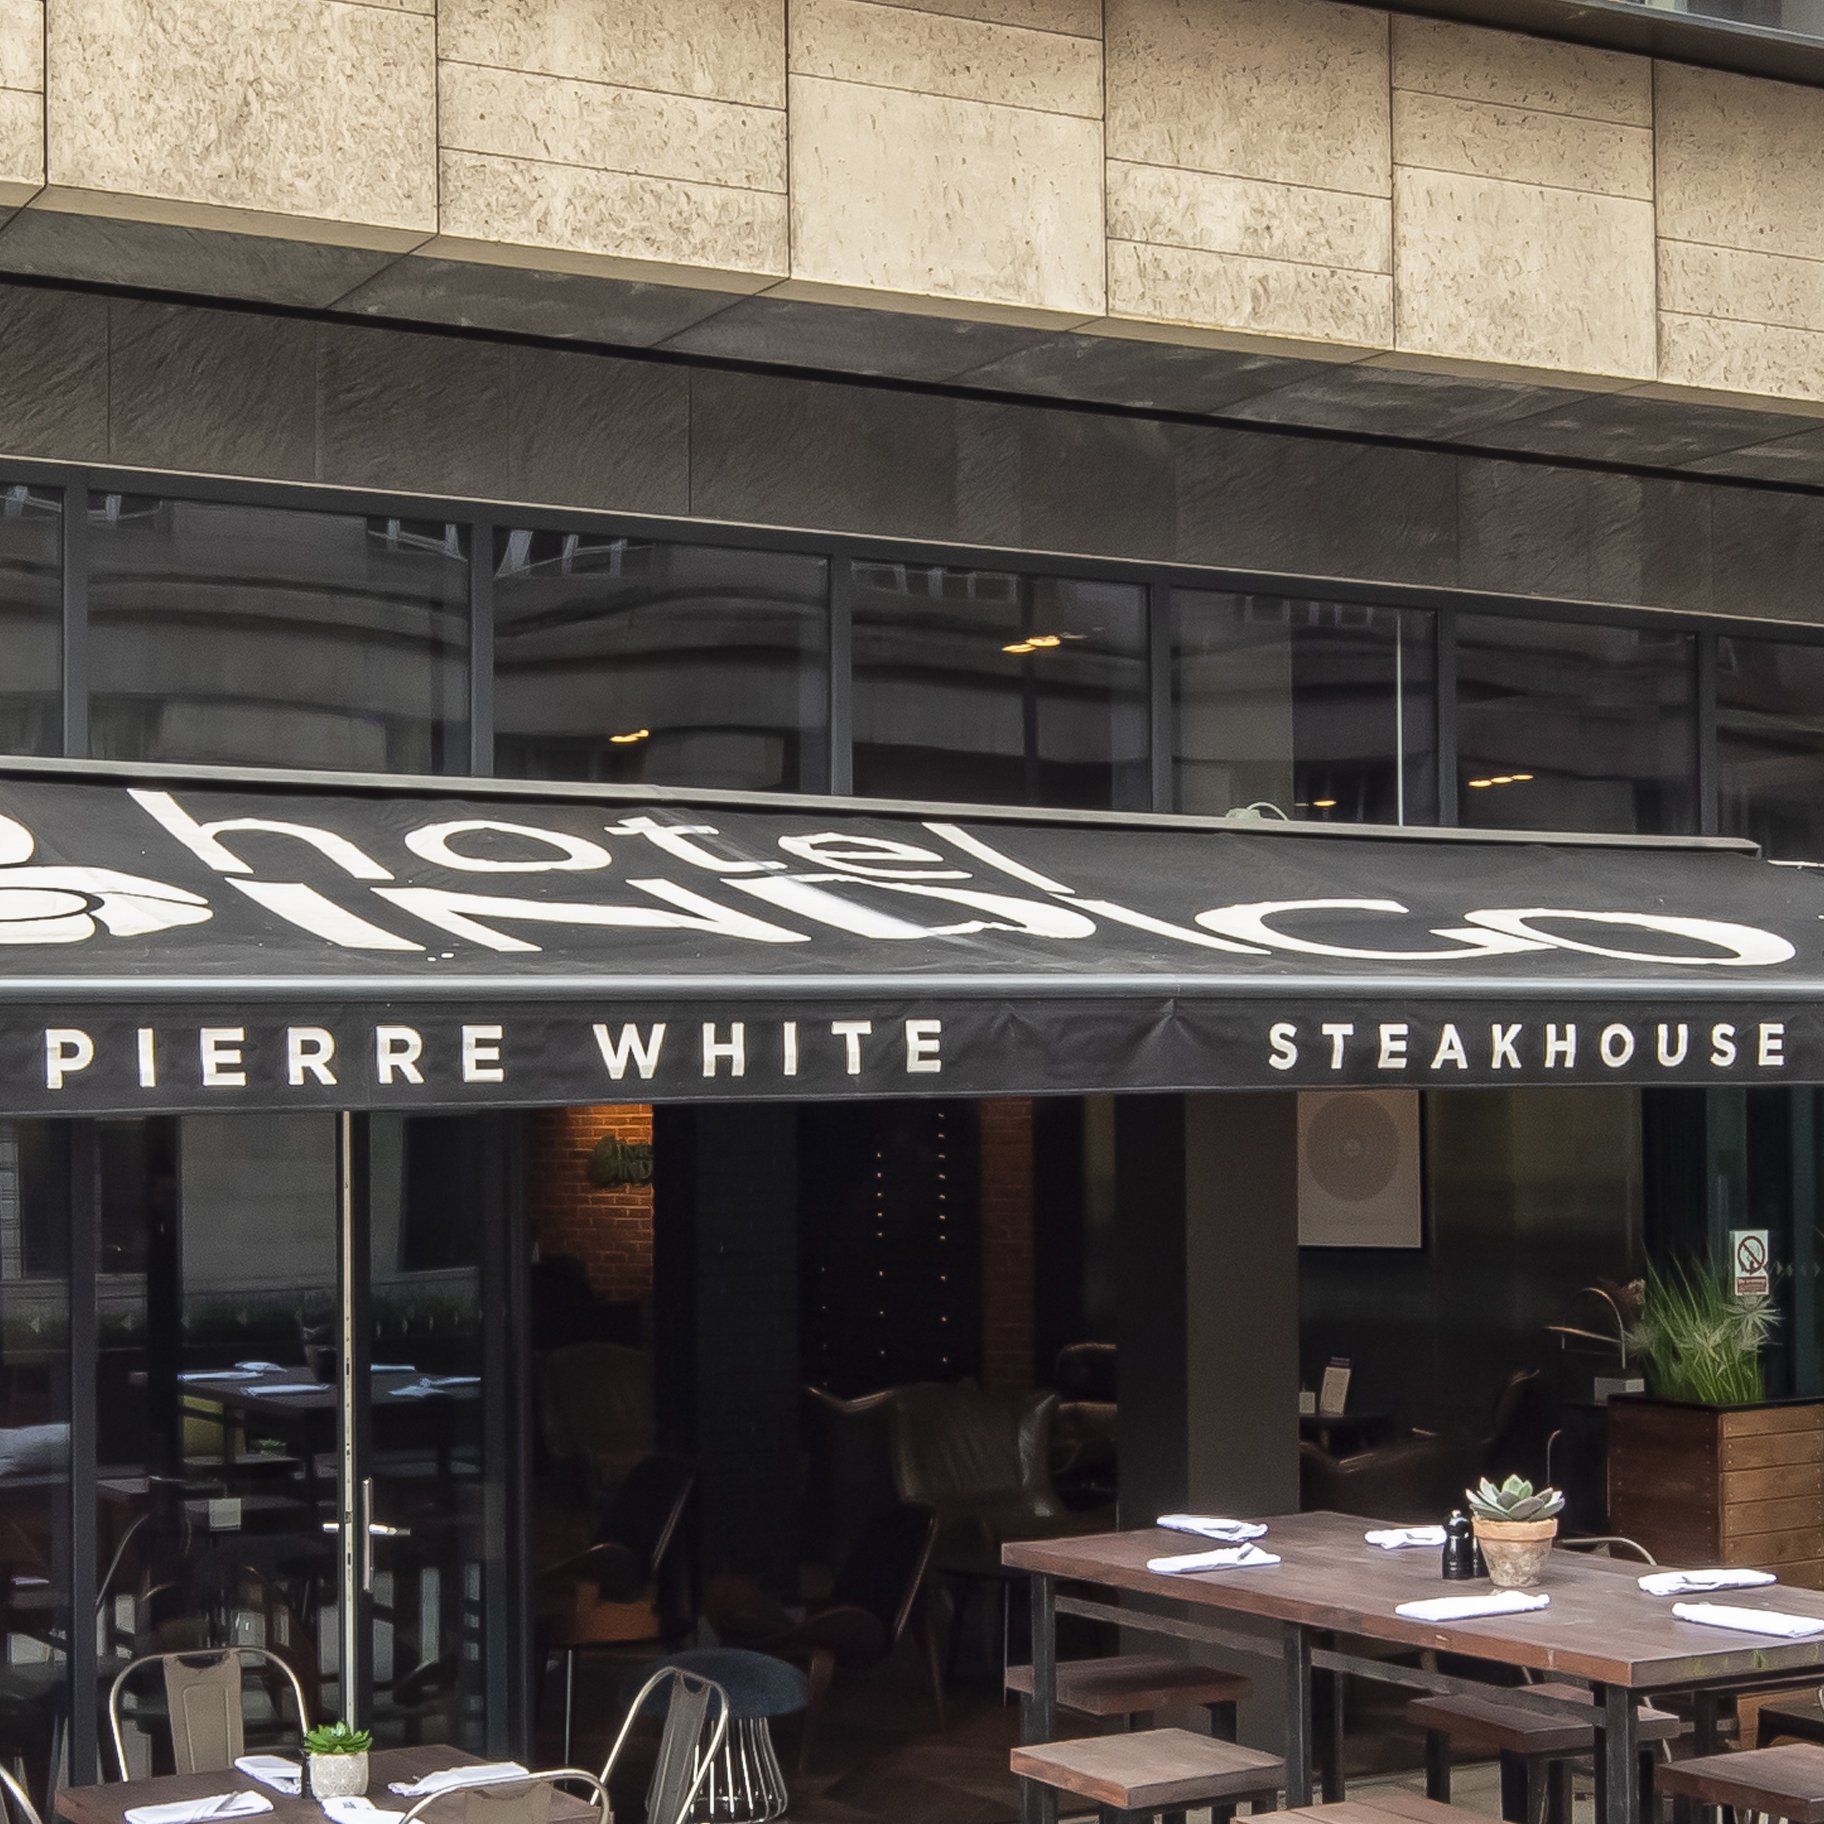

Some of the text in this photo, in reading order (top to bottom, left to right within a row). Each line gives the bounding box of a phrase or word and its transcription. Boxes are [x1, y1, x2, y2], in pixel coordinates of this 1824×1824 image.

[127, 788, 1075, 894] hotel
[224, 873, 1796, 966] INDIGO
[44, 1026, 504, 1089] PIERRE
[592, 1019, 942, 1080] WHITE
[1268, 1022, 1785, 1070] STEAKHOUSE
